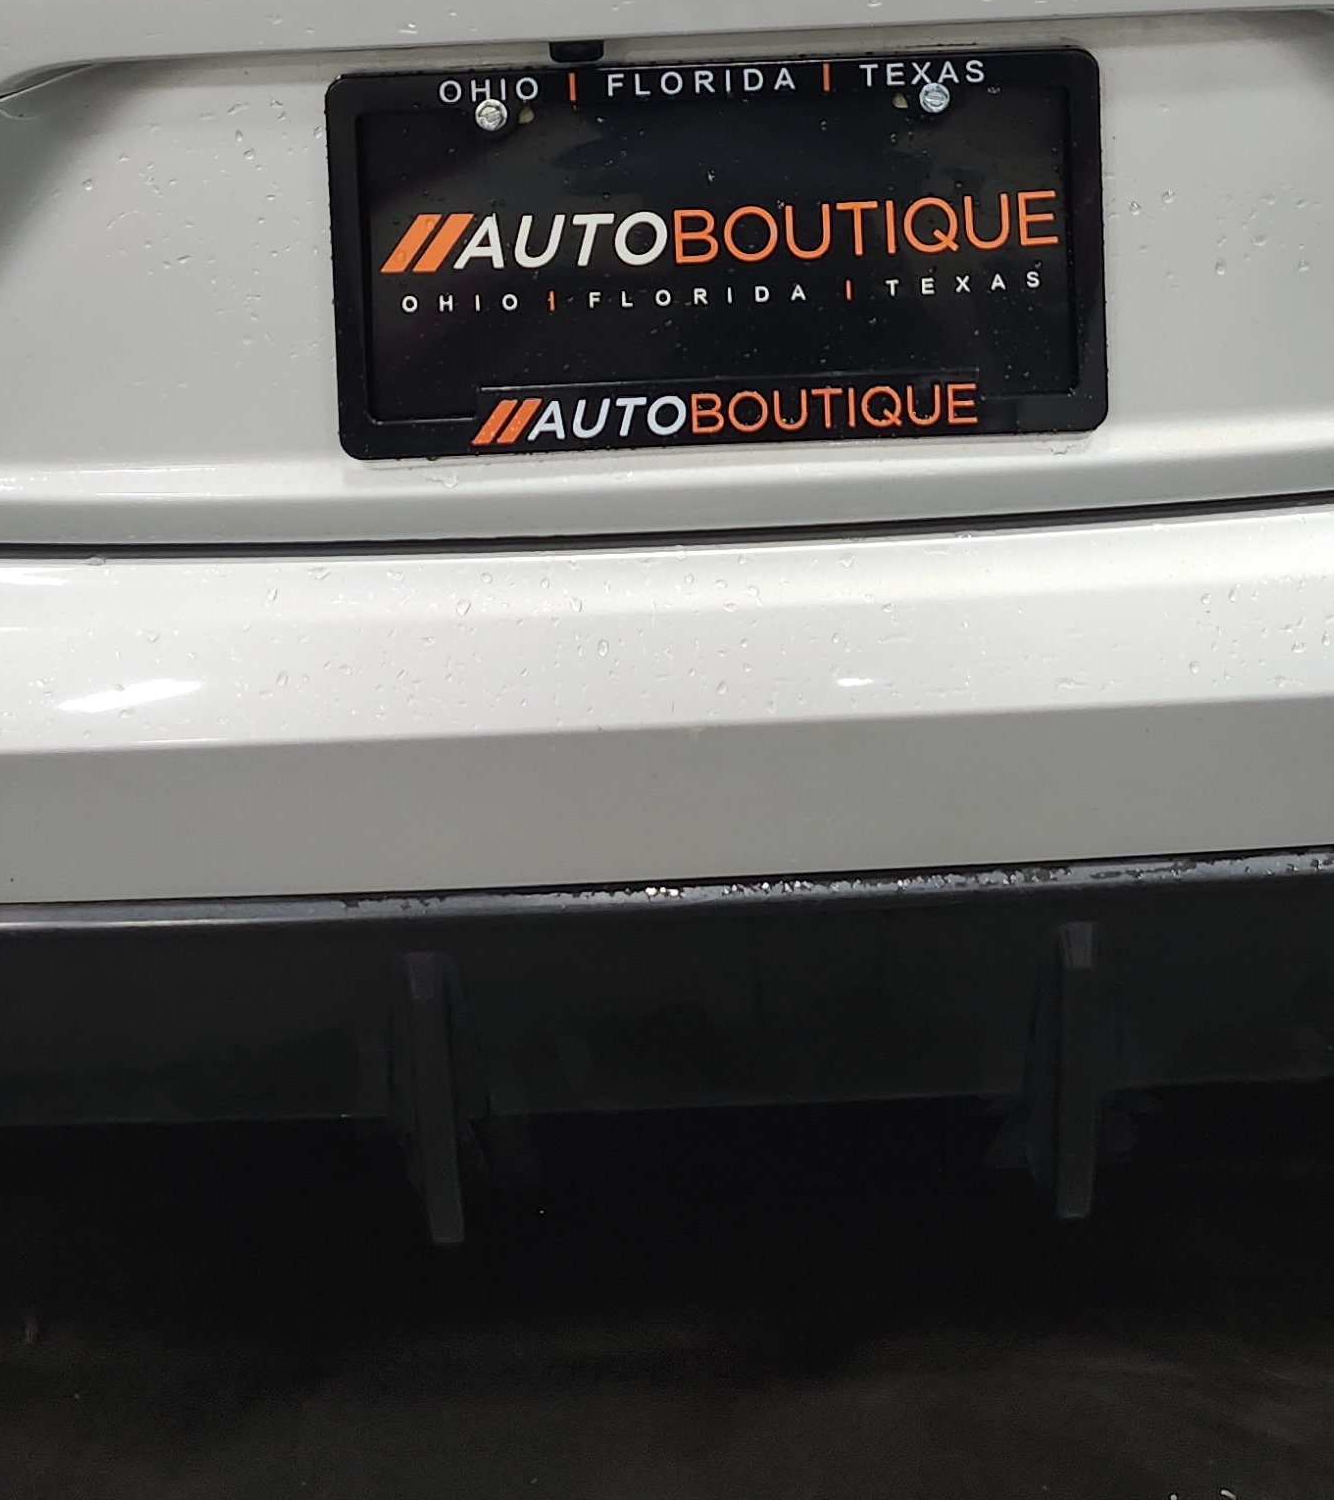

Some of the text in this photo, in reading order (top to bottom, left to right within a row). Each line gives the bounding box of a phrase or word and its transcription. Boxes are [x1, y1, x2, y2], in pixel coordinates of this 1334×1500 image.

[438, 59, 985, 103] OHIO FLORIDA TEXAS
[452, 189, 1059, 270] AUTOBOUTIQUE
[401, 271, 1040, 312] OHIO FLORIDA TEXAS
[526, 382, 978, 443] AUTOBOUTIQUE
